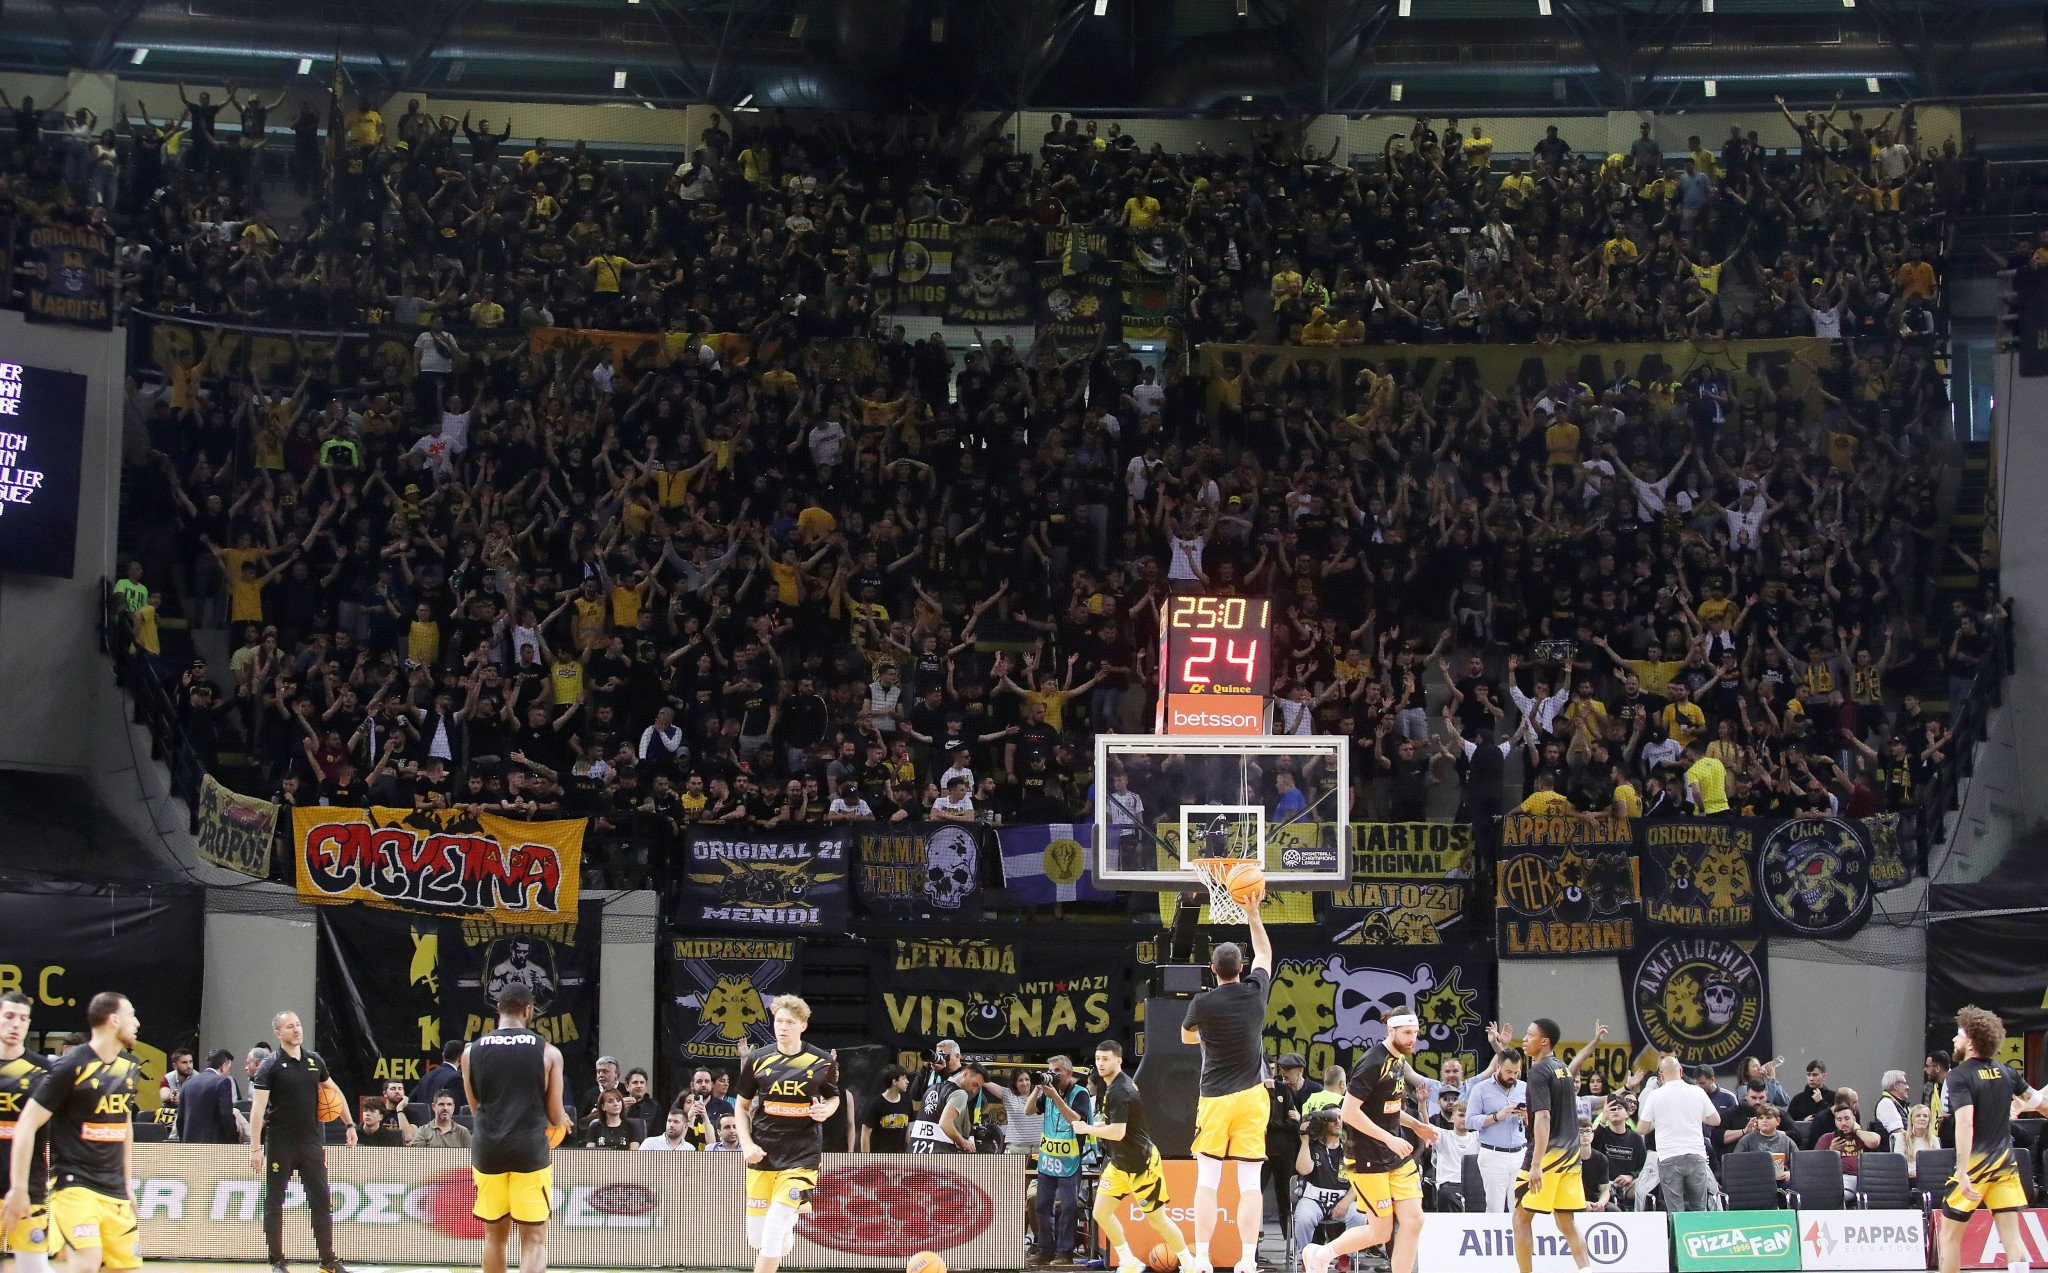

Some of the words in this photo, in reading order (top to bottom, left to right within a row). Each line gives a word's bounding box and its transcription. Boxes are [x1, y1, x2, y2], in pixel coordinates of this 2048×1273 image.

[867, 223, 952, 241] SEOLIA
[1173, 597, 1268, 629] 25:01
[1183, 637, 1257, 684] 24
[1213, 684, 1251, 694] Quince
[1174, 711, 1257, 728] betsson
[1647, 825, 1729, 847] ORIGINAL
[1735, 830, 1753, 852] 21
[693, 841, 807, 860] ORIGINAL
[818, 840, 843, 859] 21
[861, 835, 927, 864] KAMA
[1332, 883, 1421, 909] KIATO
[1426, 885, 1463, 910] 21
[702, 907, 820, 924] MENIDI
[1648, 899, 1704, 924] LAMIA
[1708, 905, 1753, 926] CLUB
[1508, 918, 1634, 954] LABRINI
[1640, 939, 1753, 995] AMFILOCHIA
[1068, 975, 1108, 992] NAZI
[1642, 1008, 1685, 1058] ALWAYS
[1686, 1045, 1704, 1062] BY
[1708, 1030, 1745, 1060] YOUR
[1738, 996, 1757, 1032] SIDE
[480, 1034, 536, 1047] macron
[687, 1043, 759, 1058] ORIGIN
[374, 1057, 420, 1080] AEK
[769, 1080, 808, 1097] AEK
[0, 1093, 23, 1112] EK
[95, 1093, 132, 1114] AEK
[919, 1123, 935, 1137] HB
[912, 1139, 935, 1154] 121
[1040, 1136, 1071, 1154] POTO
[1041, 1156, 1063, 1173] 059
[1458, 1229, 1573, 1257] Allinz
[1844, 1225, 1919, 1244] PAPPAS
[1844, 1245, 1921, 1253] ELEVATORS
